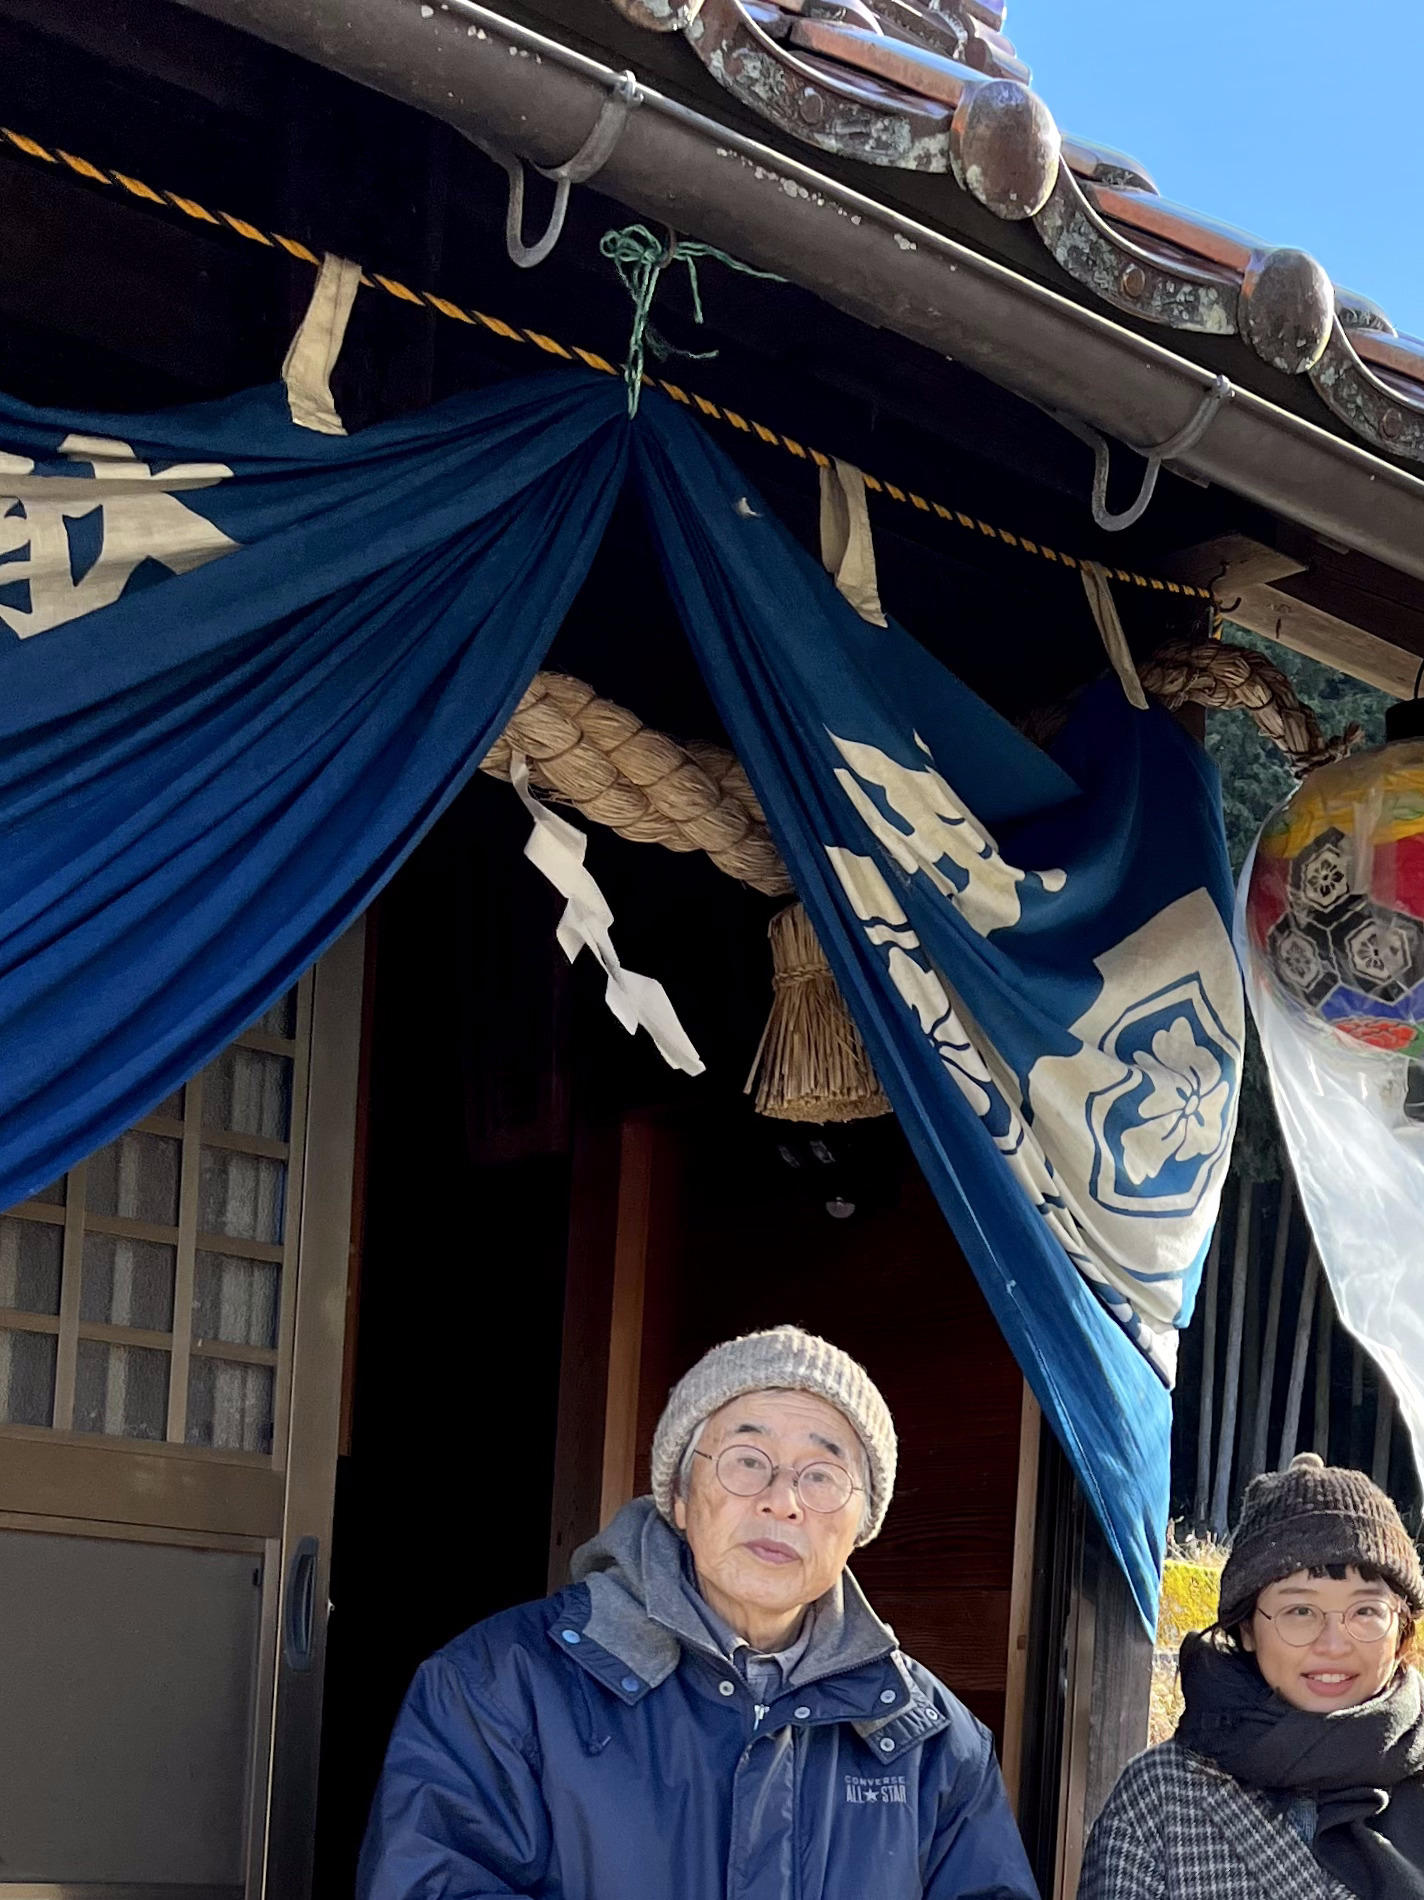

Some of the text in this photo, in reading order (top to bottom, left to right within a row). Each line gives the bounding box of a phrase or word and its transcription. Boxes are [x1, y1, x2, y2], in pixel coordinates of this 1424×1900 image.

[844, 1775, 906, 1786] CONVERSE
[846, 1785, 906, 1803] ALL STAR
